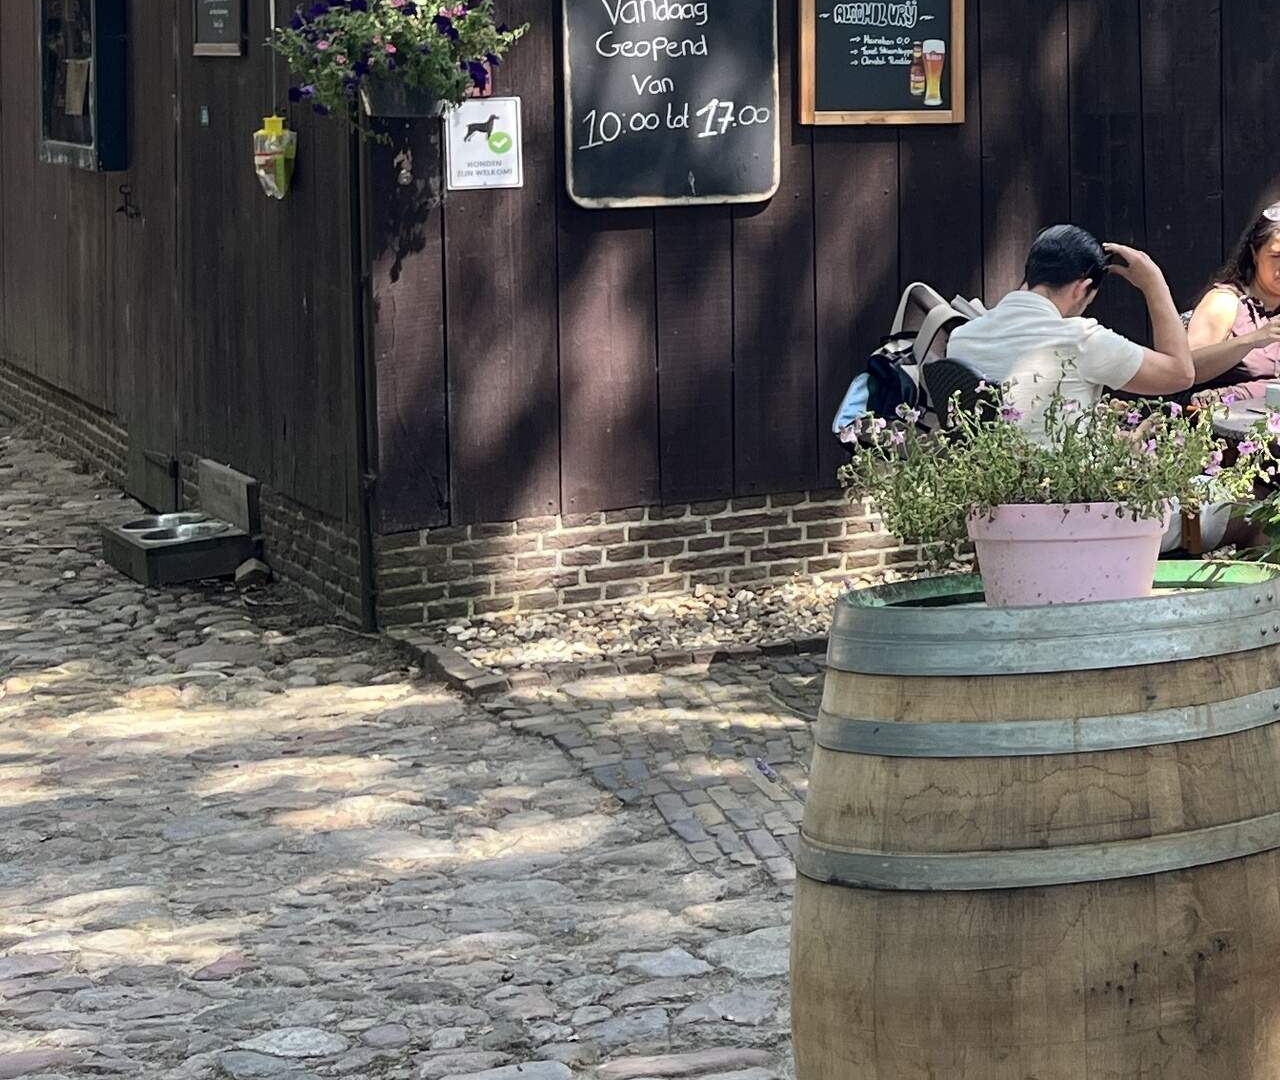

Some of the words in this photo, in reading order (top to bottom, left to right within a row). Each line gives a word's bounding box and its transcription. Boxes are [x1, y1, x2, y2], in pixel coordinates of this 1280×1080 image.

[595, 30, 709, 61] Geopend
[578, 108, 660, 150] 10:00
[666, 102, 690, 130] tot
[695, 98, 771, 139] 17.00
